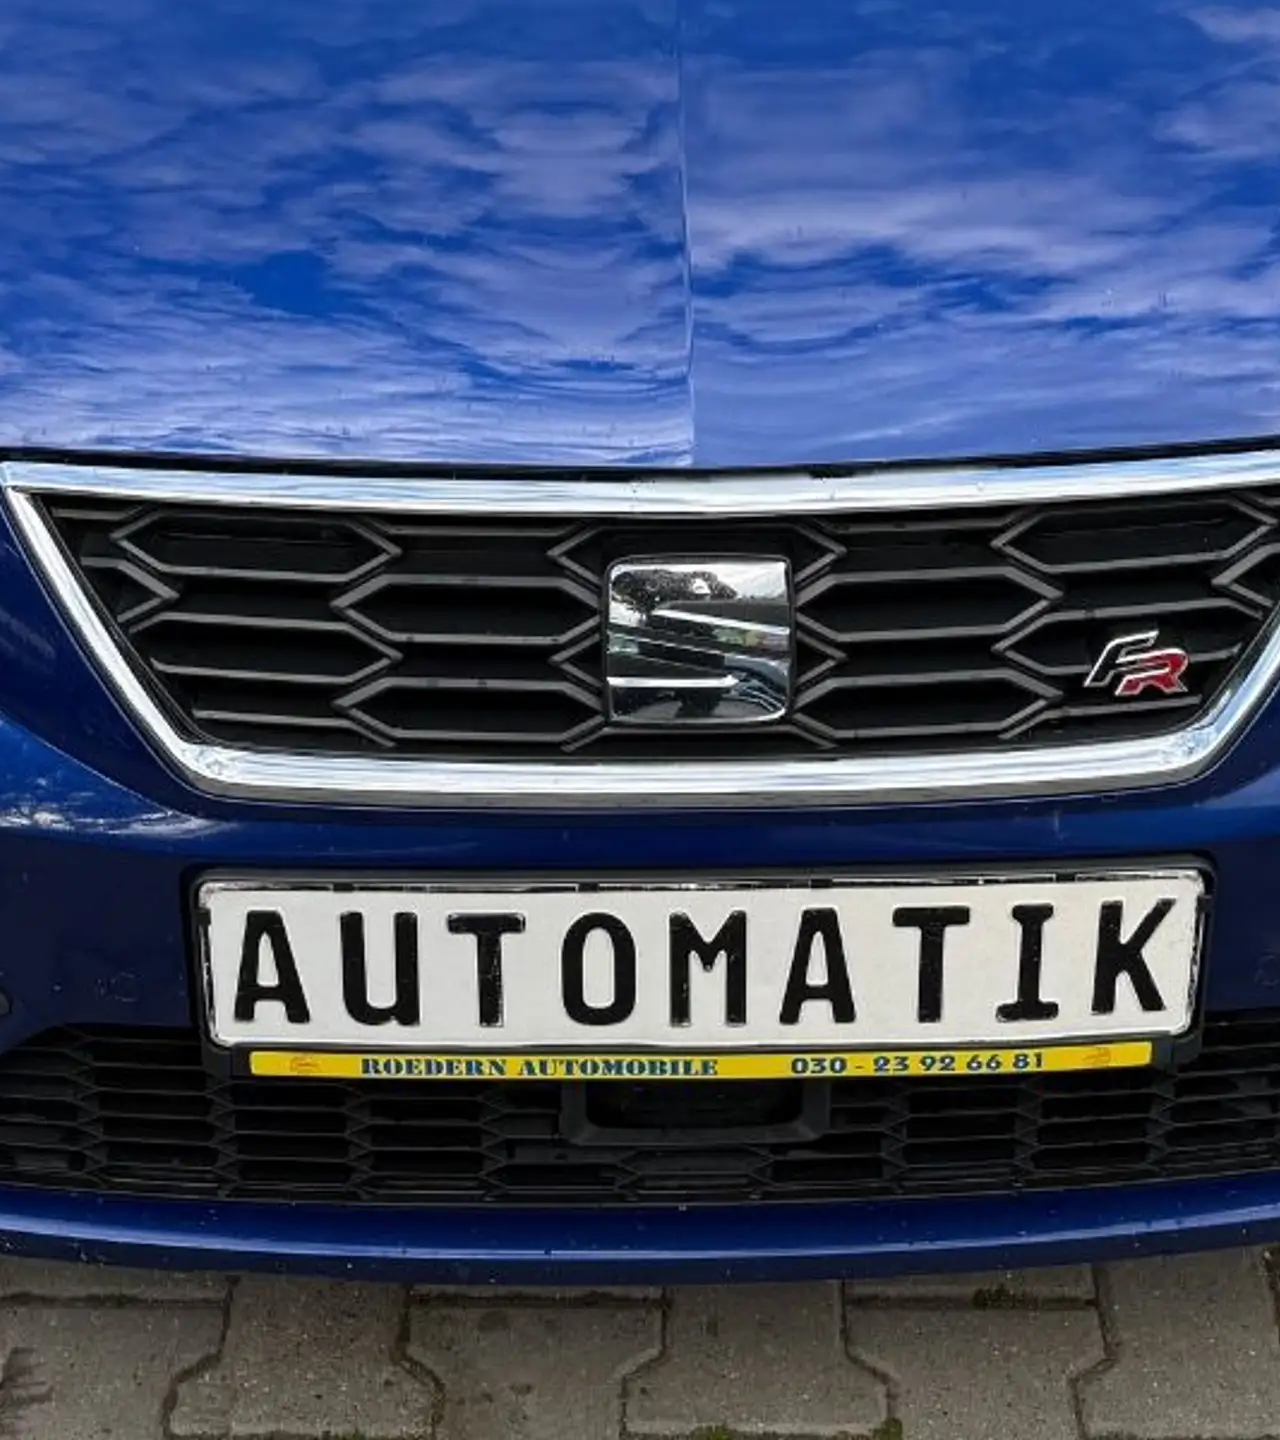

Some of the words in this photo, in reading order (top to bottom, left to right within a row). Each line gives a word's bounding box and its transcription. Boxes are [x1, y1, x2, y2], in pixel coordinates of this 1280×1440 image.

[1083, 629, 1190, 697] FR
[231, 895, 1179, 1029] AUTOMATIK
[361, 1057, 508, 1077] ROEDERN
[518, 1058, 719, 1077] AUTOMOBILE
[789, 1056, 847, 1075] 030
[873, 1054, 910, 1073] 23
[920, 1053, 957, 1072] 92
[966, 1053, 1003, 1071] 66
[1012, 1051, 1045, 1070] 81
